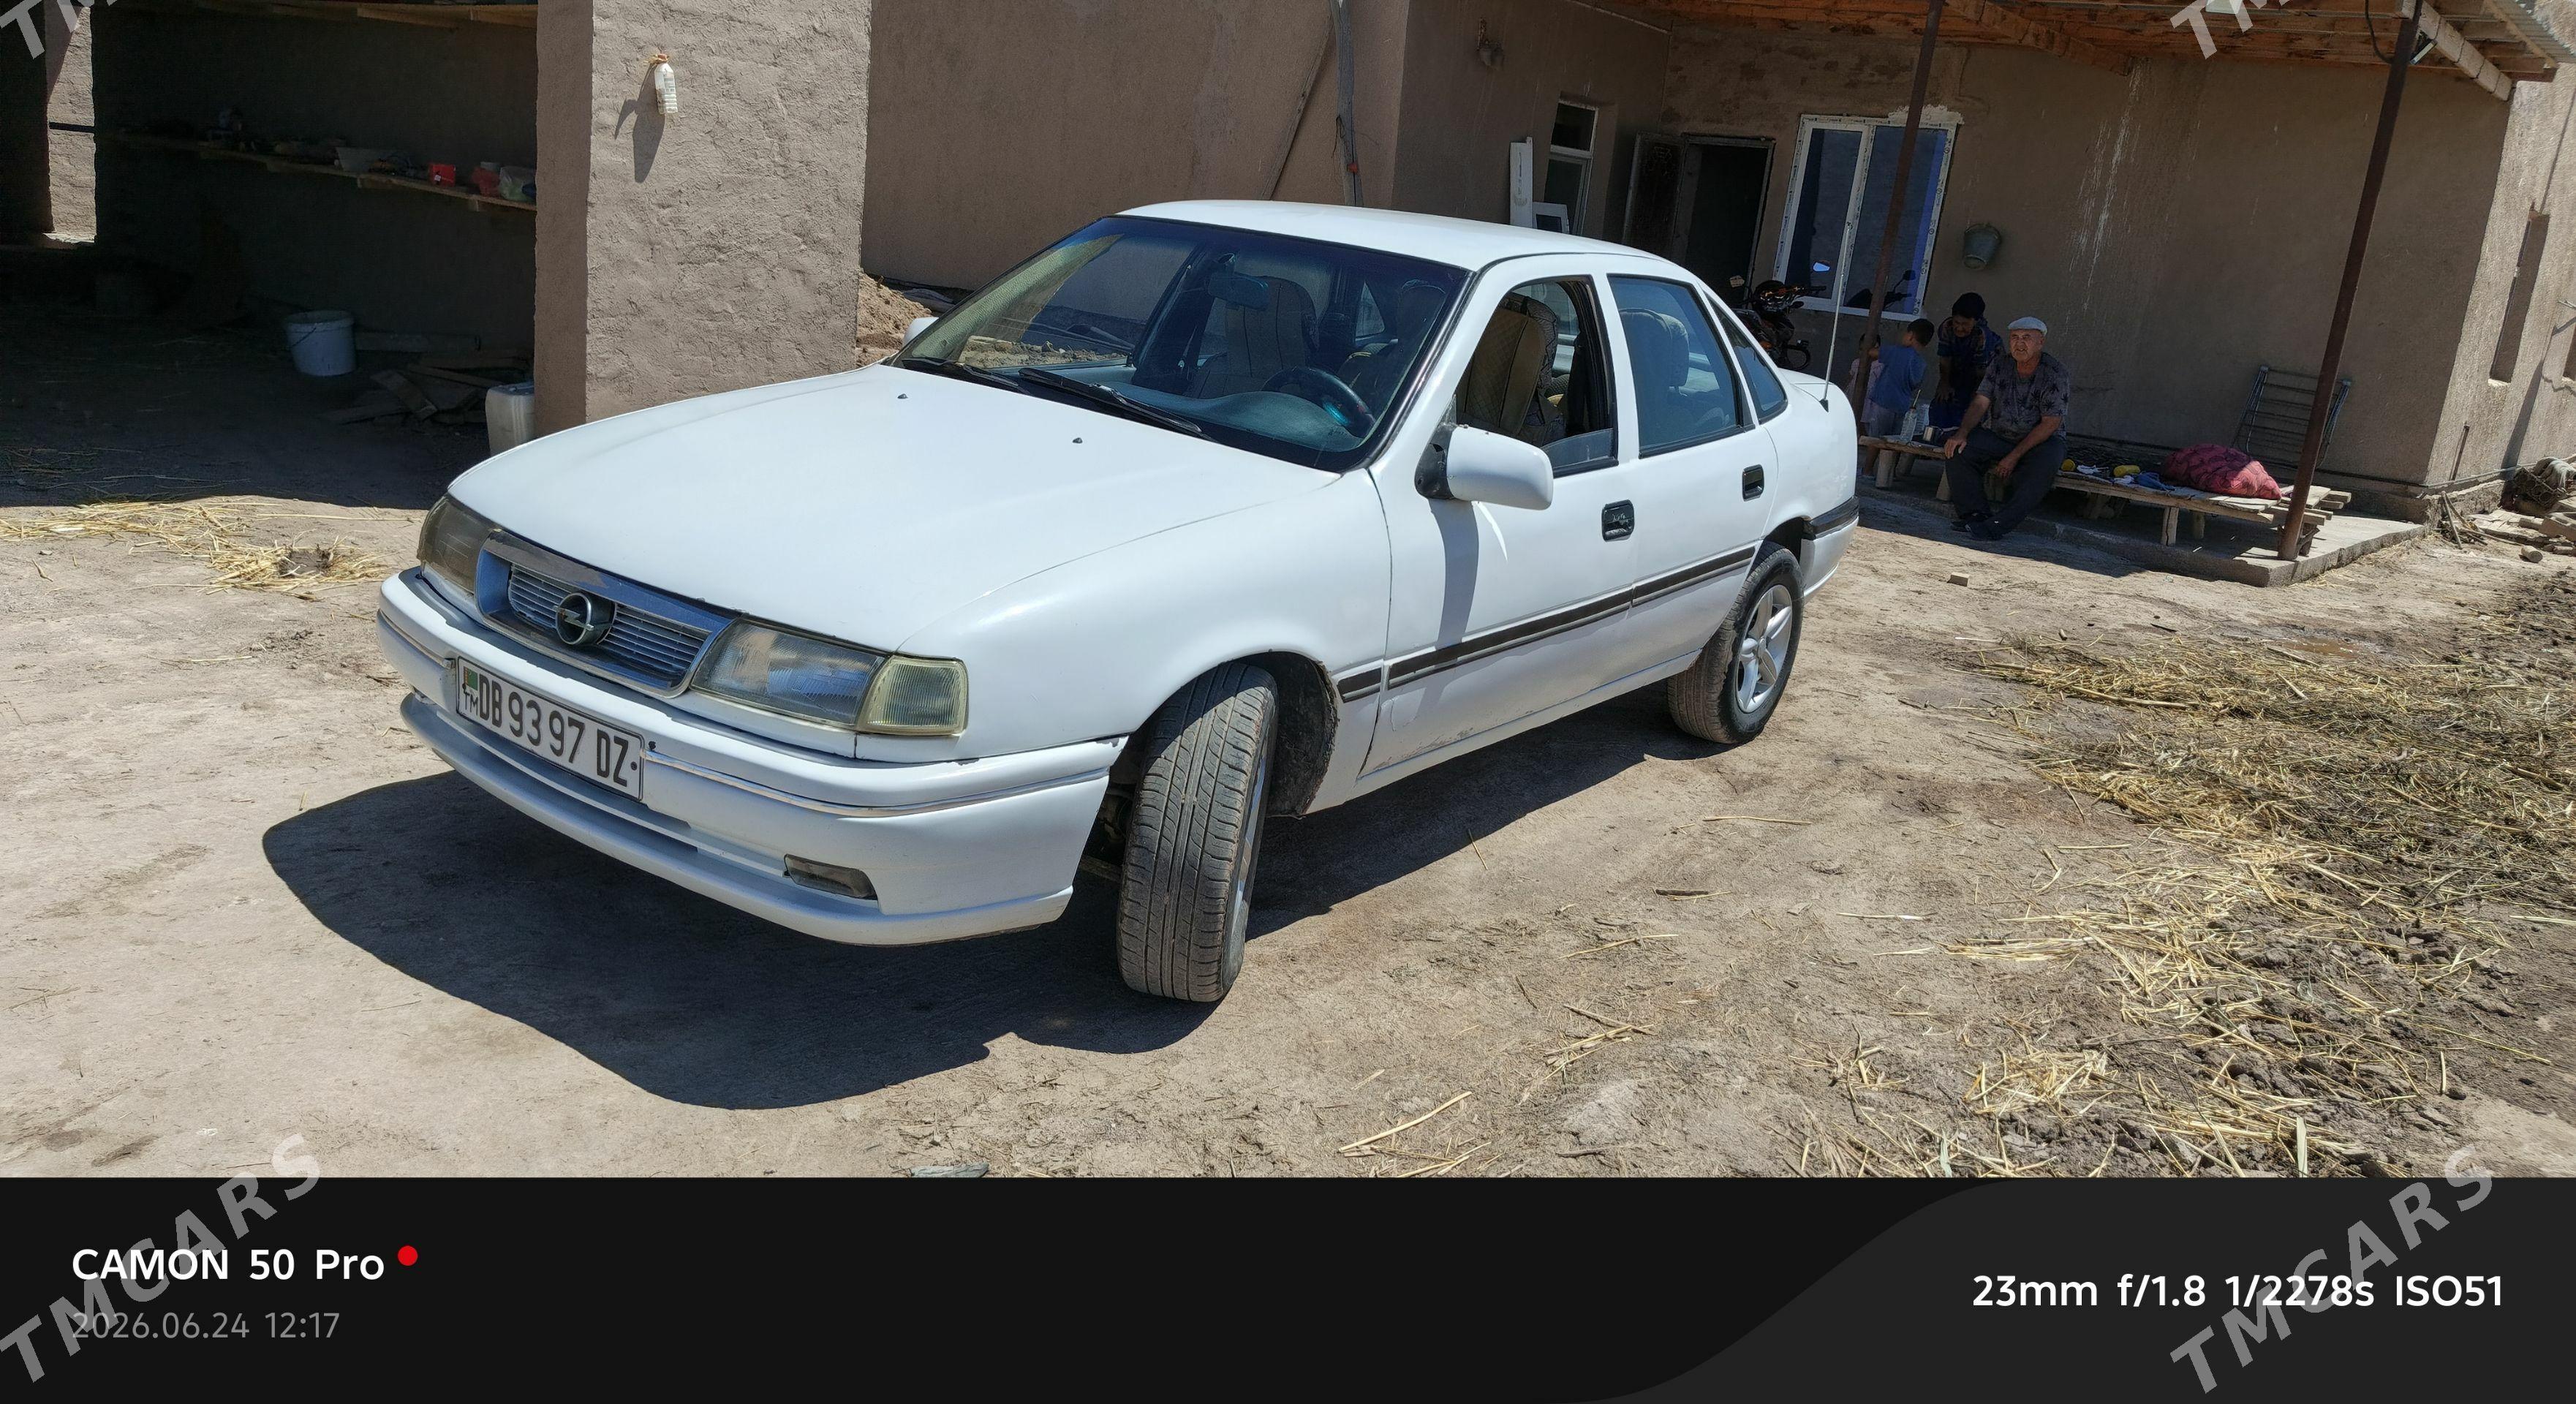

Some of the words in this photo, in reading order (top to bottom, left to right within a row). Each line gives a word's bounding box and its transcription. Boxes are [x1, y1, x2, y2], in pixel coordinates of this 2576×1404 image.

[479, 673, 502, 728] DB
[508, 691, 542, 747] 93
[549, 710, 585, 763] 97
[596, 728, 629, 787] DZ
